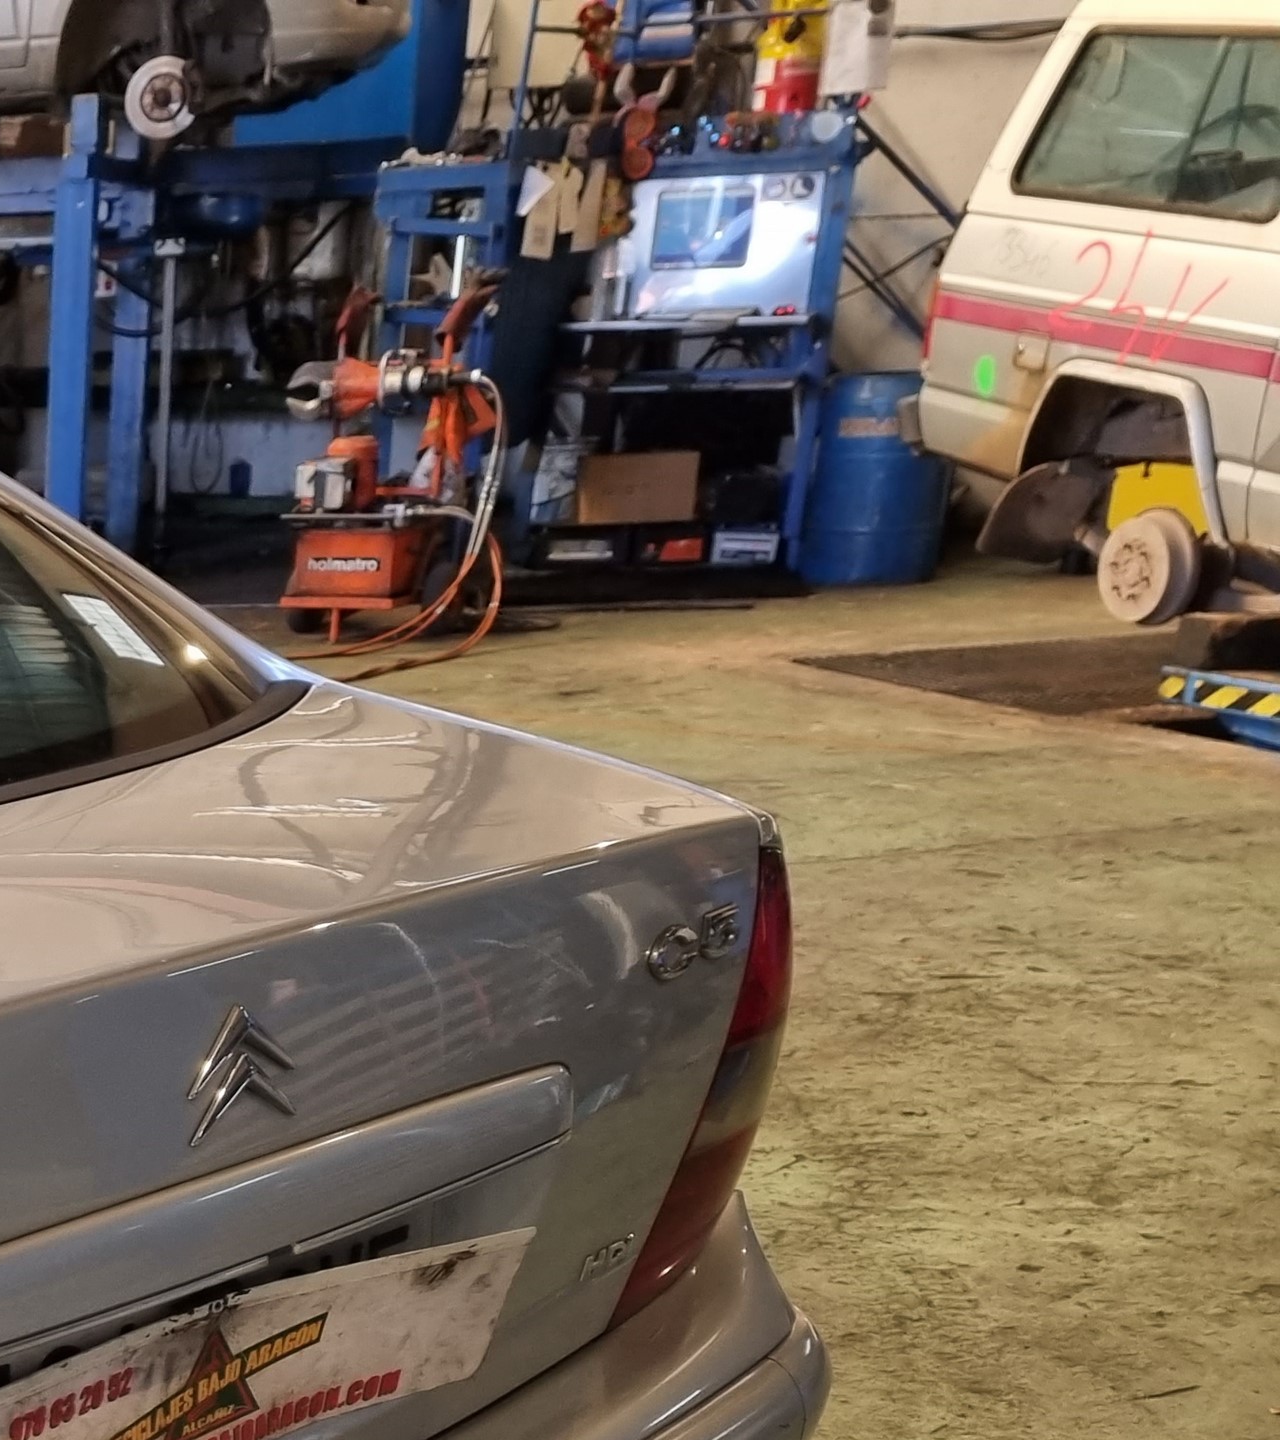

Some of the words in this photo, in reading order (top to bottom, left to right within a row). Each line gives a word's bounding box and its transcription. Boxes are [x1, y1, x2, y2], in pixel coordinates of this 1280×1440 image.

[307, 557, 379, 572] holmatro
[647, 903, 739, 981] C5
[107, 1367, 134, 1402] 52
[197, 1357, 243, 1404] BAJO
[244, 1320, 322, 1375] ARAGÓN
